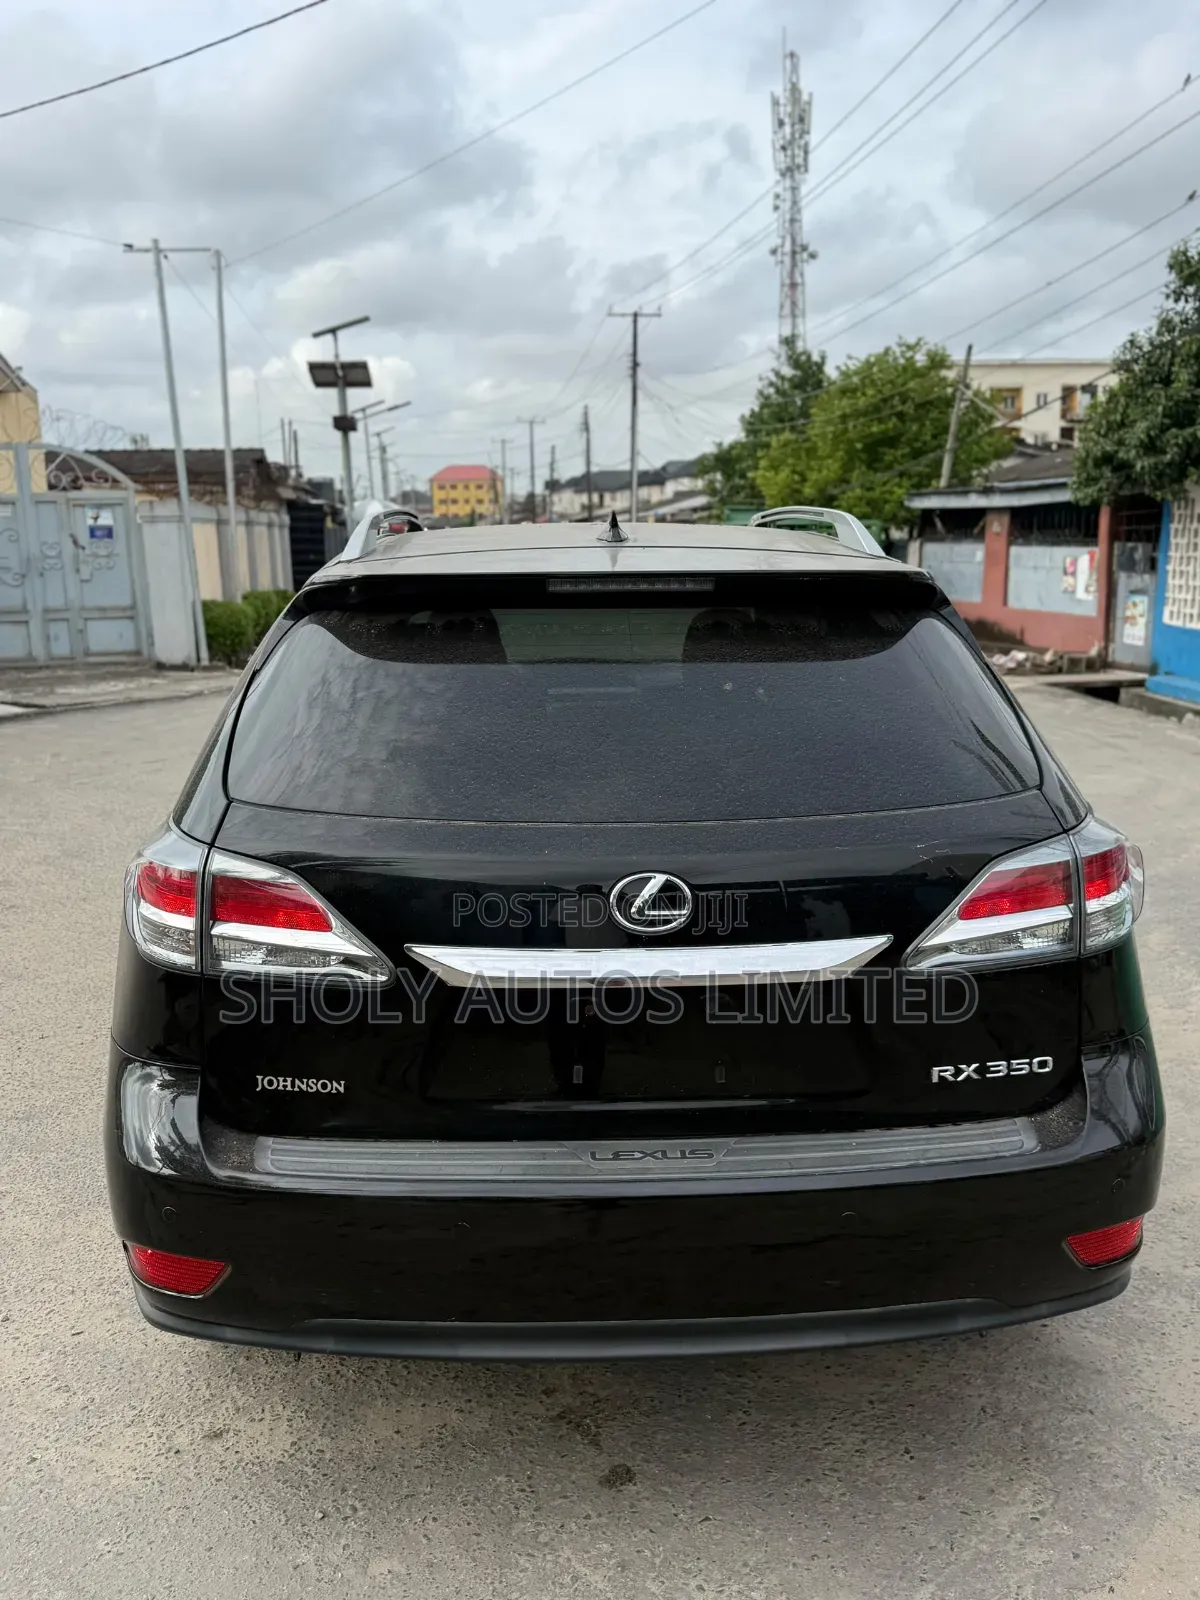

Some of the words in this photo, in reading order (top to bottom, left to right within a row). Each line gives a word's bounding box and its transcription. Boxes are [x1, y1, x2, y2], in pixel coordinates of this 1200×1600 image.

[930, 1063, 982, 1083] RX
[985, 1056, 1054, 1078] 350
[255, 1075, 346, 1094] JOHNSON
[589, 1148, 716, 1162] LEXUS
